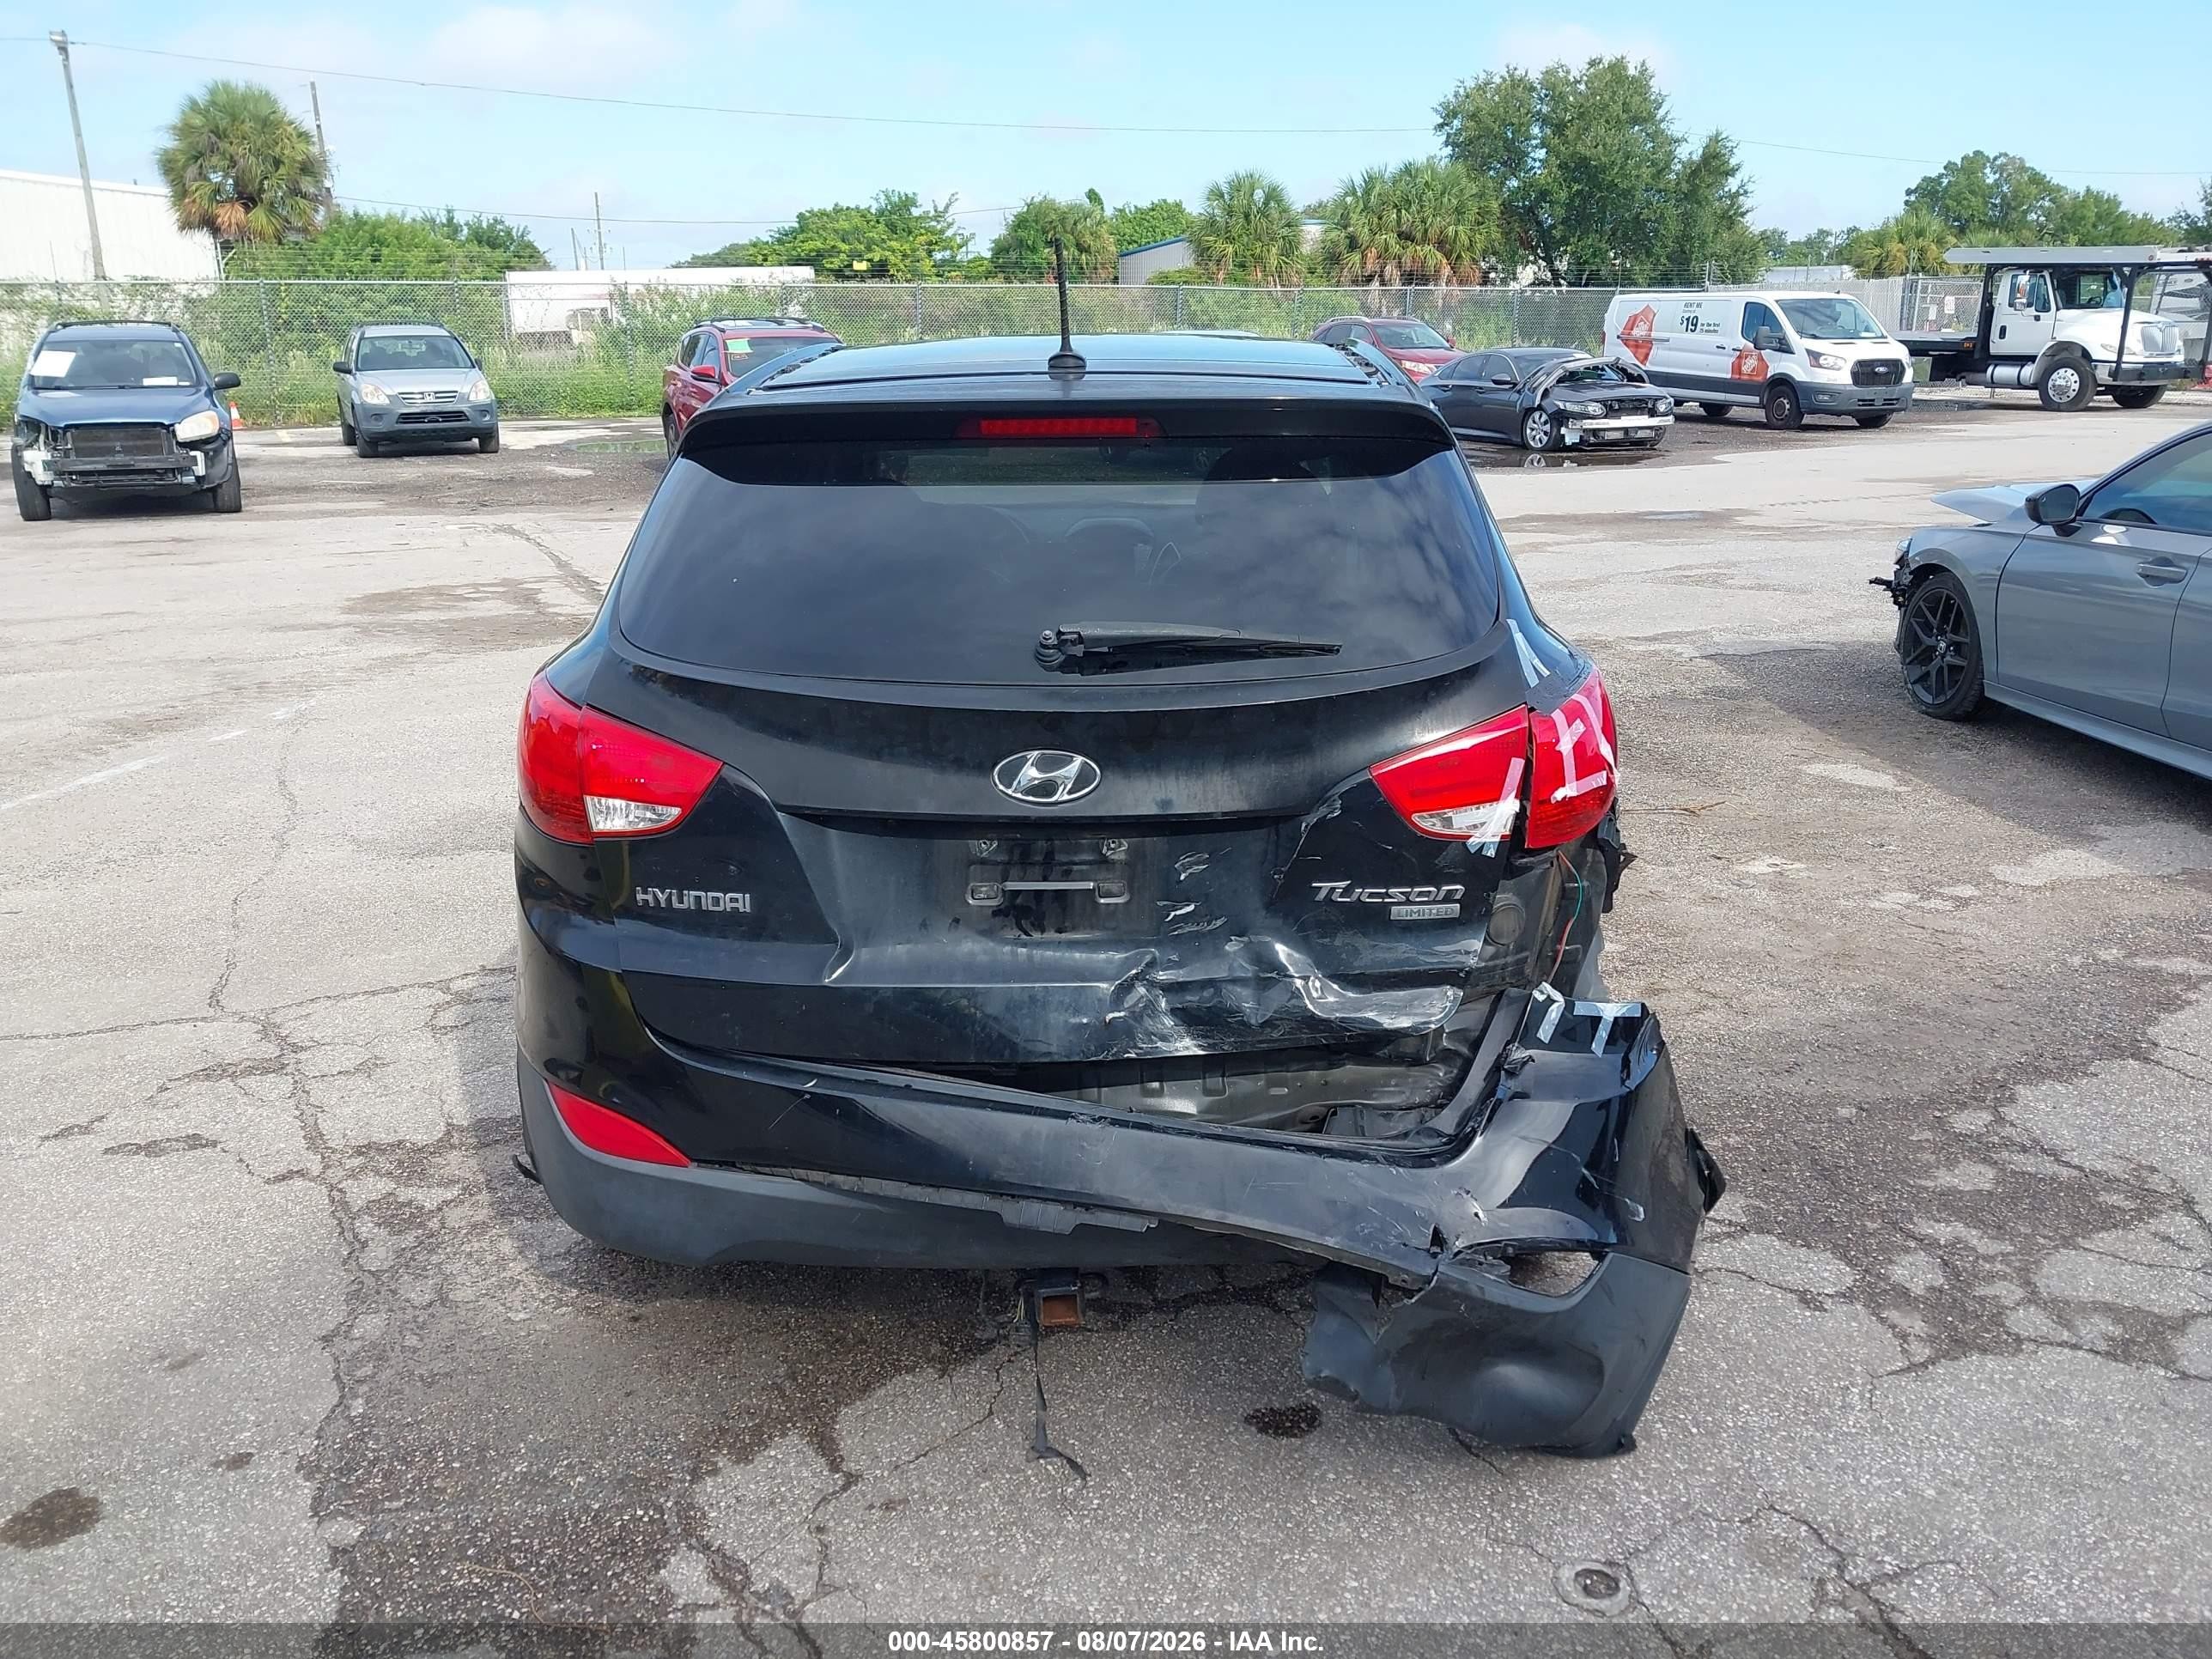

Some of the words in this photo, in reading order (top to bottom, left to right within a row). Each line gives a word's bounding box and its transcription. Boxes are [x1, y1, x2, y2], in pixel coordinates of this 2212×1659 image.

[1680, 315, 1699, 333] $19
[635, 886, 751, 914] HYUNDAI
[1395, 906, 1455, 918] LIMITED
